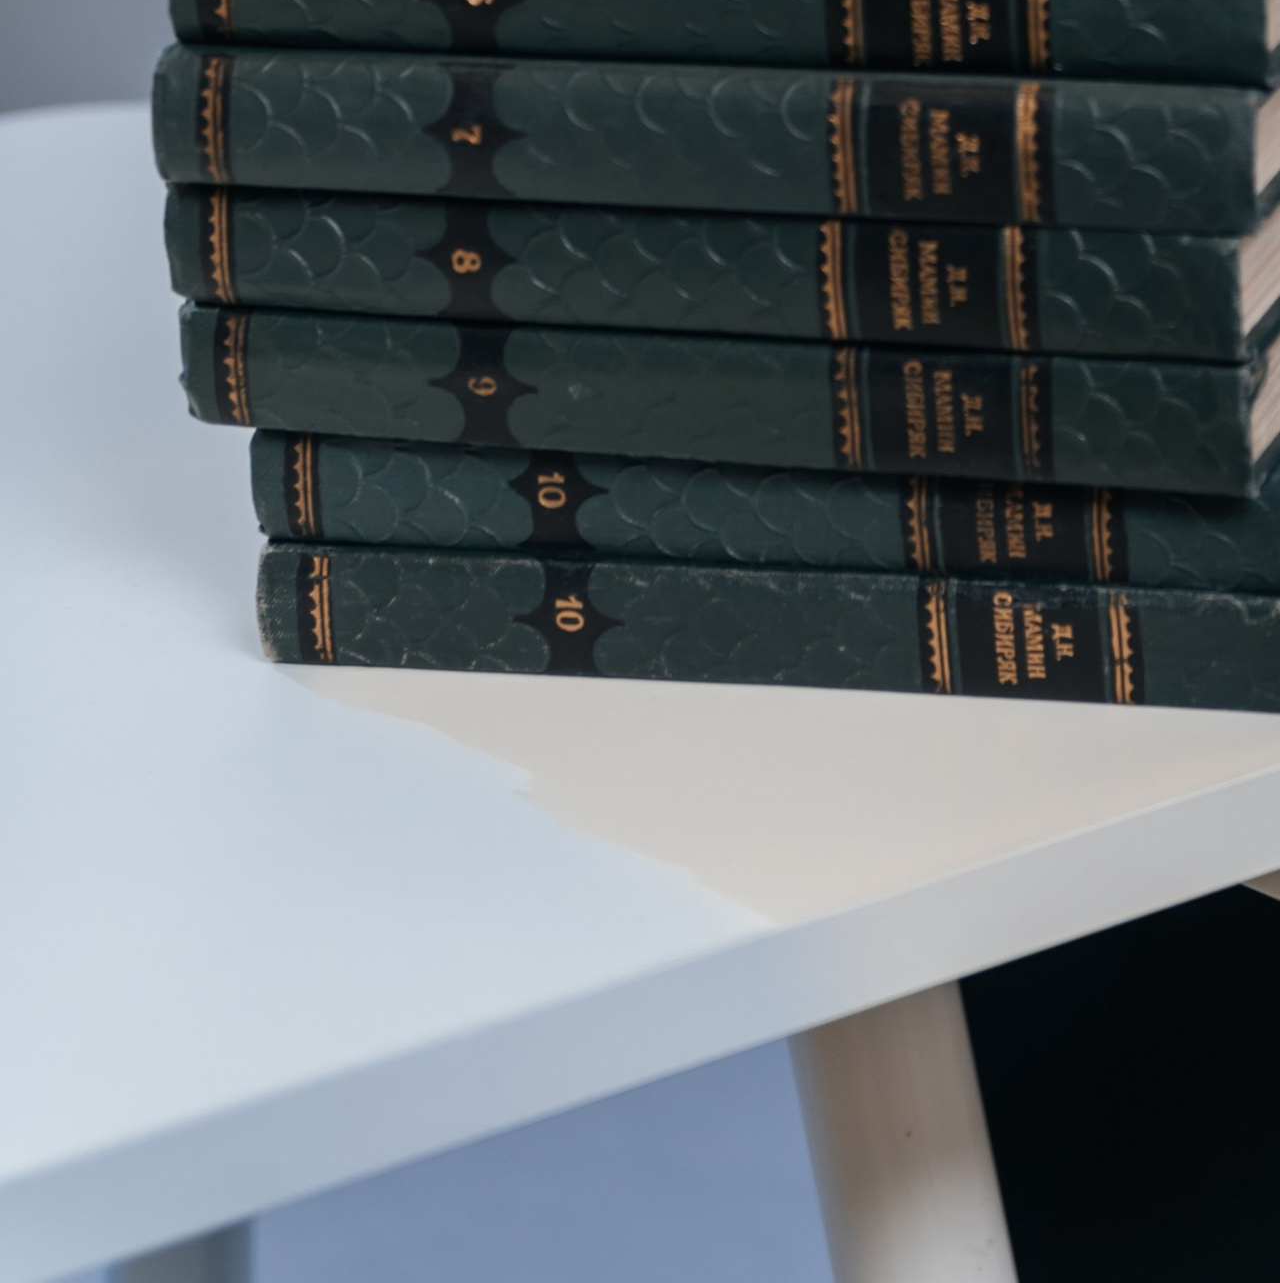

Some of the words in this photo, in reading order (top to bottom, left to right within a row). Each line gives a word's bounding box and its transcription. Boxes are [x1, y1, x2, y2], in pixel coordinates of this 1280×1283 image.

[451, 124, 483, 146] 7
[450, 247, 482, 274] 8
[889, 230, 913, 330] СИБИРЯК
[917, 240, 940, 325] МАМИН
[467, 376, 497, 397] 9
[902, 359, 926, 459] СИБИРЯК
[933, 370, 955, 454] МАМИН
[536, 471, 568, 510] 10
[554, 594, 587, 634] 10
[991, 591, 1019, 686] СИБИРЯК
[1021, 603, 1047, 681] МАМИН
